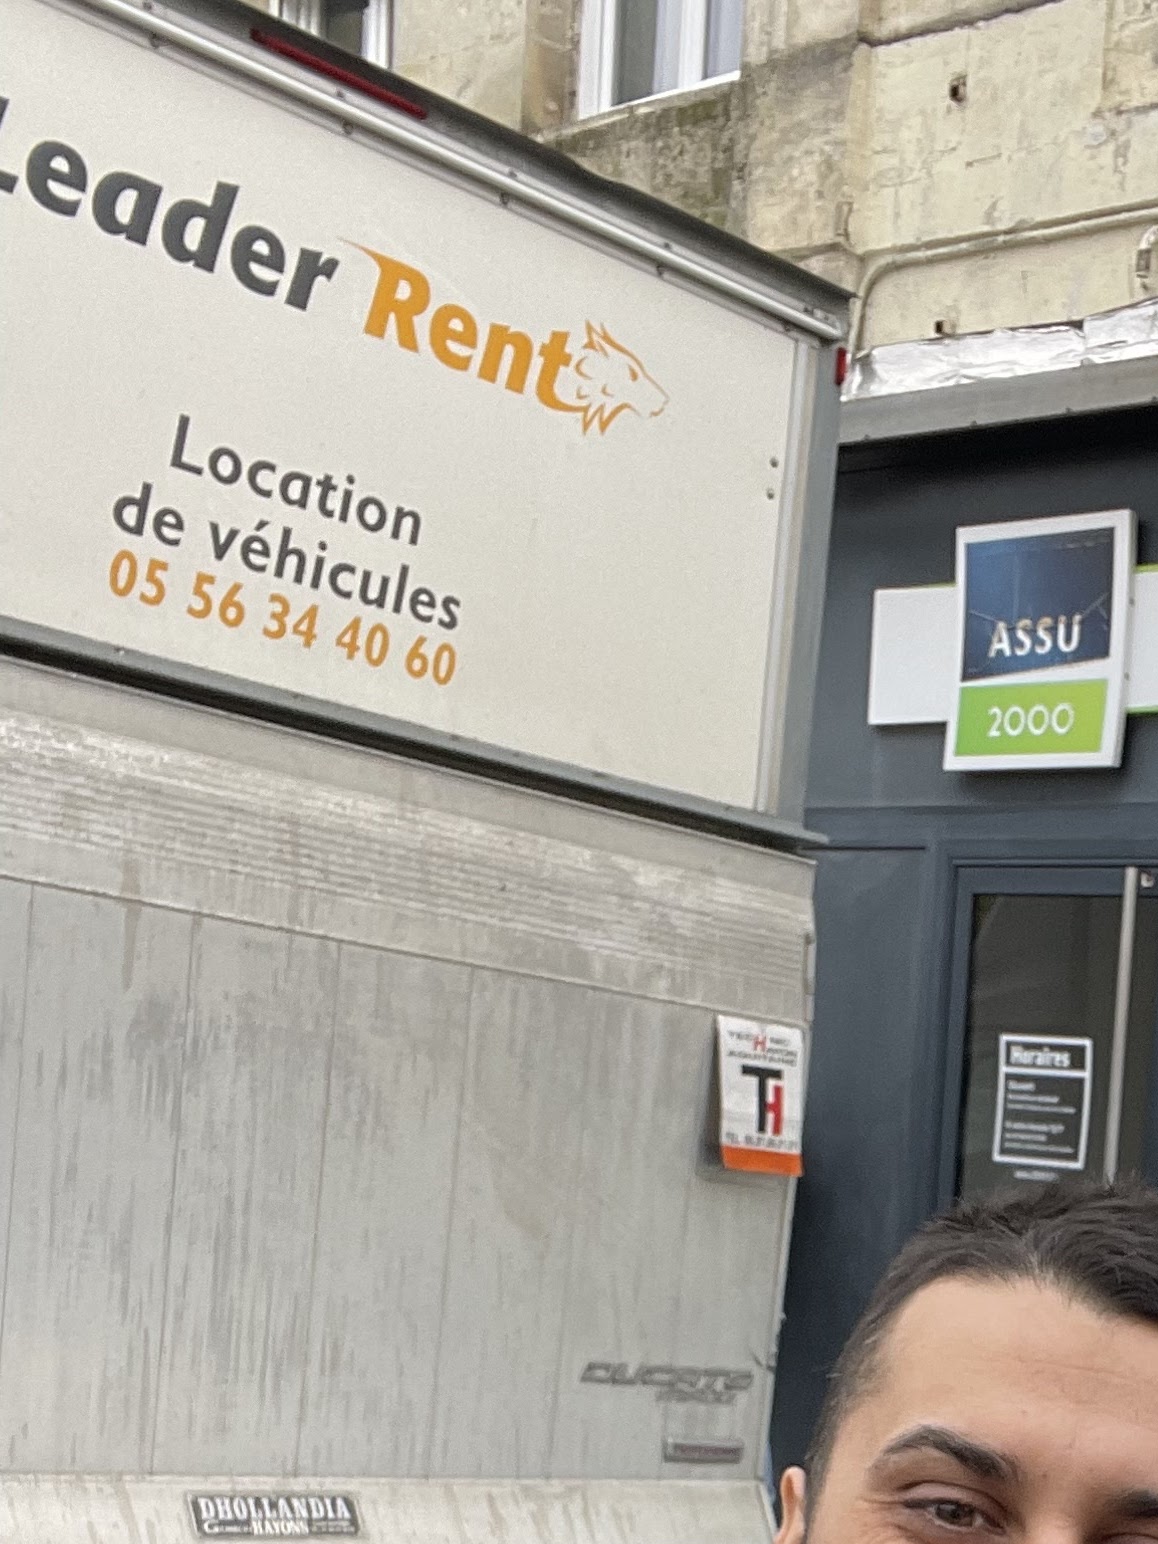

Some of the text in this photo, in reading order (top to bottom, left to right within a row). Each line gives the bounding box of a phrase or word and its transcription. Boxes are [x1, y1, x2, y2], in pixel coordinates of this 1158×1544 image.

[340, 238, 592, 413] Rent
[169, 413, 422, 546] Location
[108, 549, 457, 686] 05 56 34 40 60
[112, 481, 461, 630] de véhicules
[988, 612, 1083, 659] ASSU
[987, 702, 1076, 737] 2000
[198, 1497, 351, 1521] DHOLLANDIA
